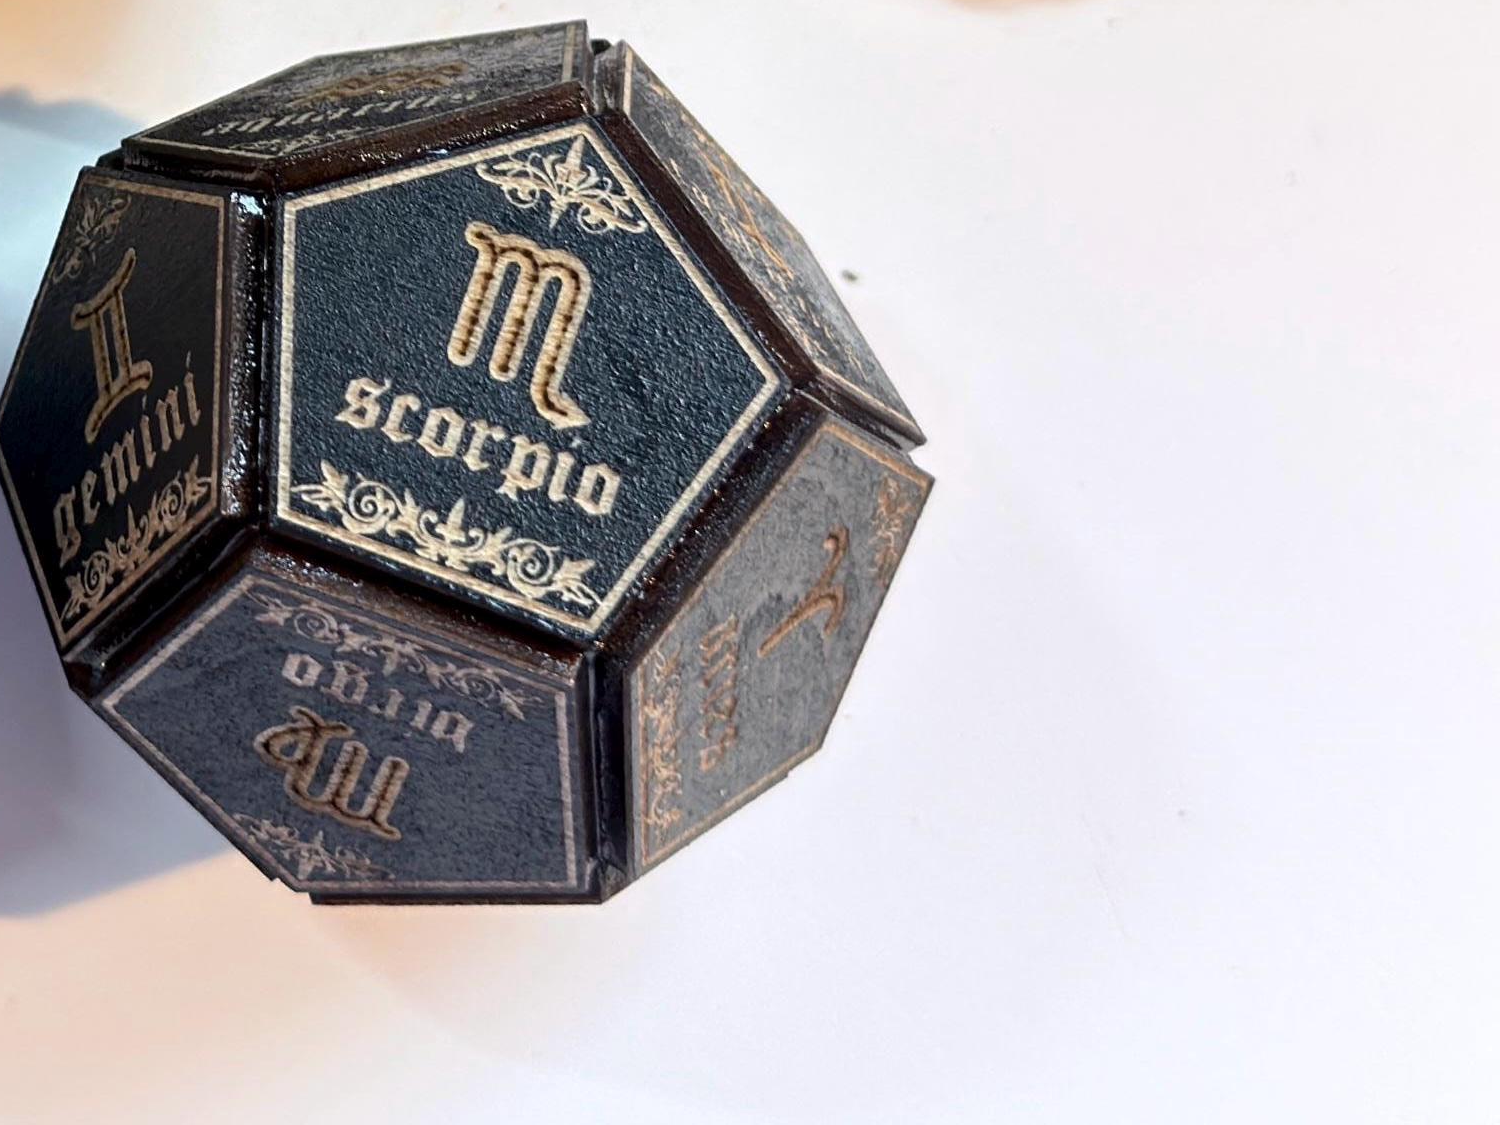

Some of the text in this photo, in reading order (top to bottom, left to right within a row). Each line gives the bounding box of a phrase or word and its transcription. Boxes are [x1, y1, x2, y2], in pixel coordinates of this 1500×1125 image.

[51, 349, 202, 568] gemini
[334, 375, 622, 517] scorpio
[281, 652, 475, 754] virgo
